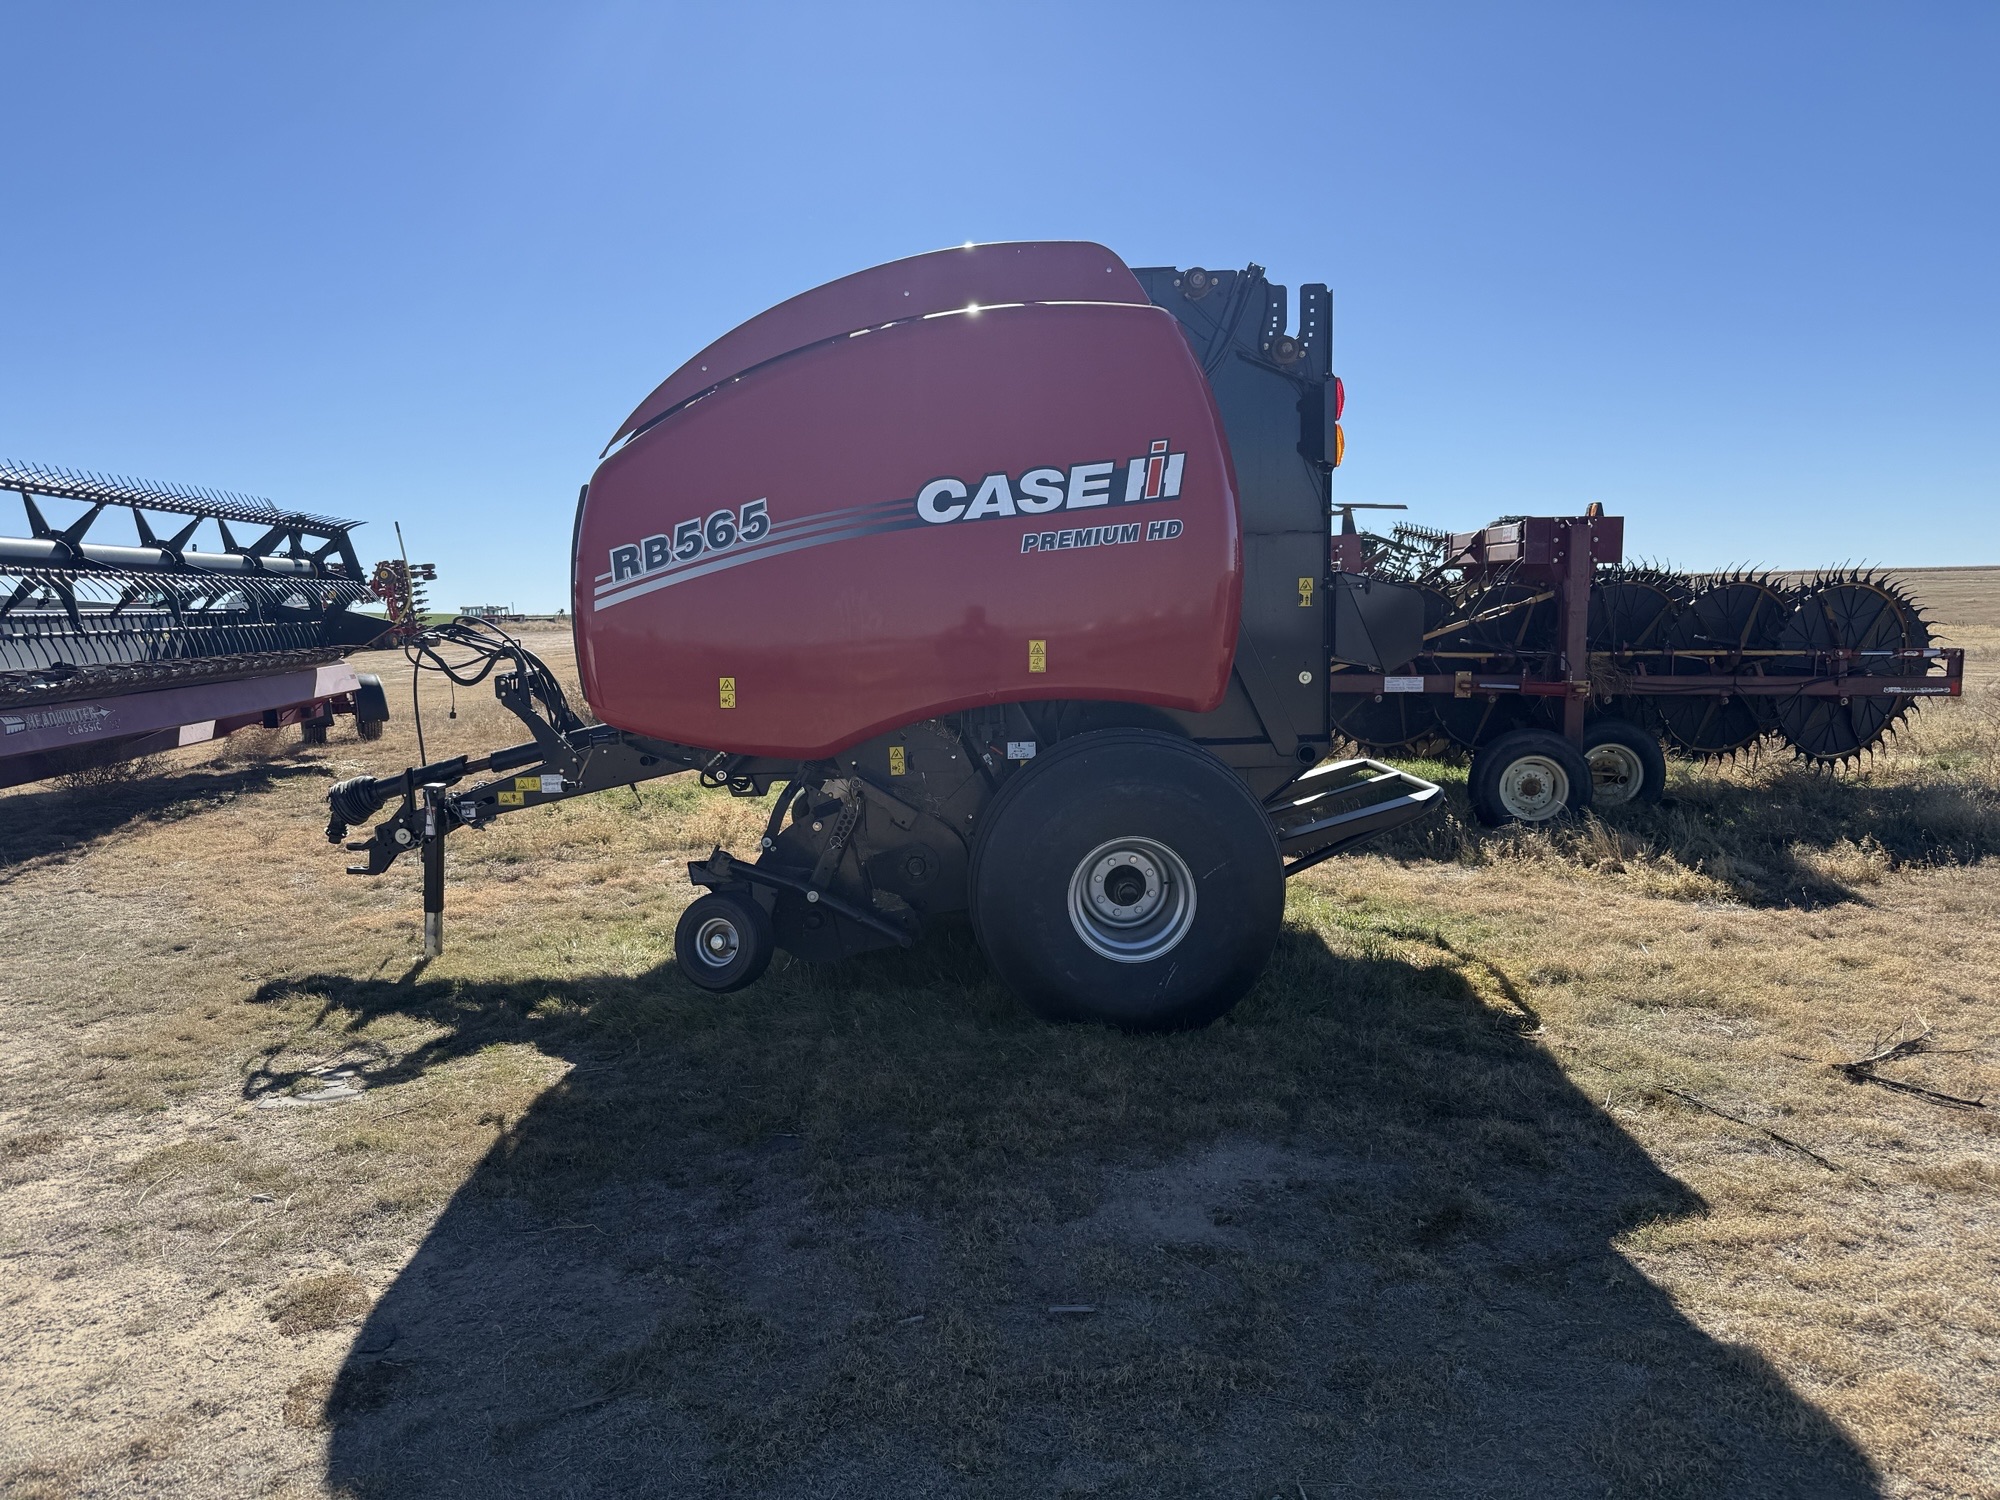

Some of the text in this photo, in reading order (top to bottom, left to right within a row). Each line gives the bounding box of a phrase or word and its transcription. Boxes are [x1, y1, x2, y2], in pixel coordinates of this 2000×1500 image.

[917, 461, 1114, 524] CASE
[609, 497, 771, 585] RB565
[1020, 519, 1184, 554] PREMIUM HD
[67, 721, 102, 736] CLASSIC
